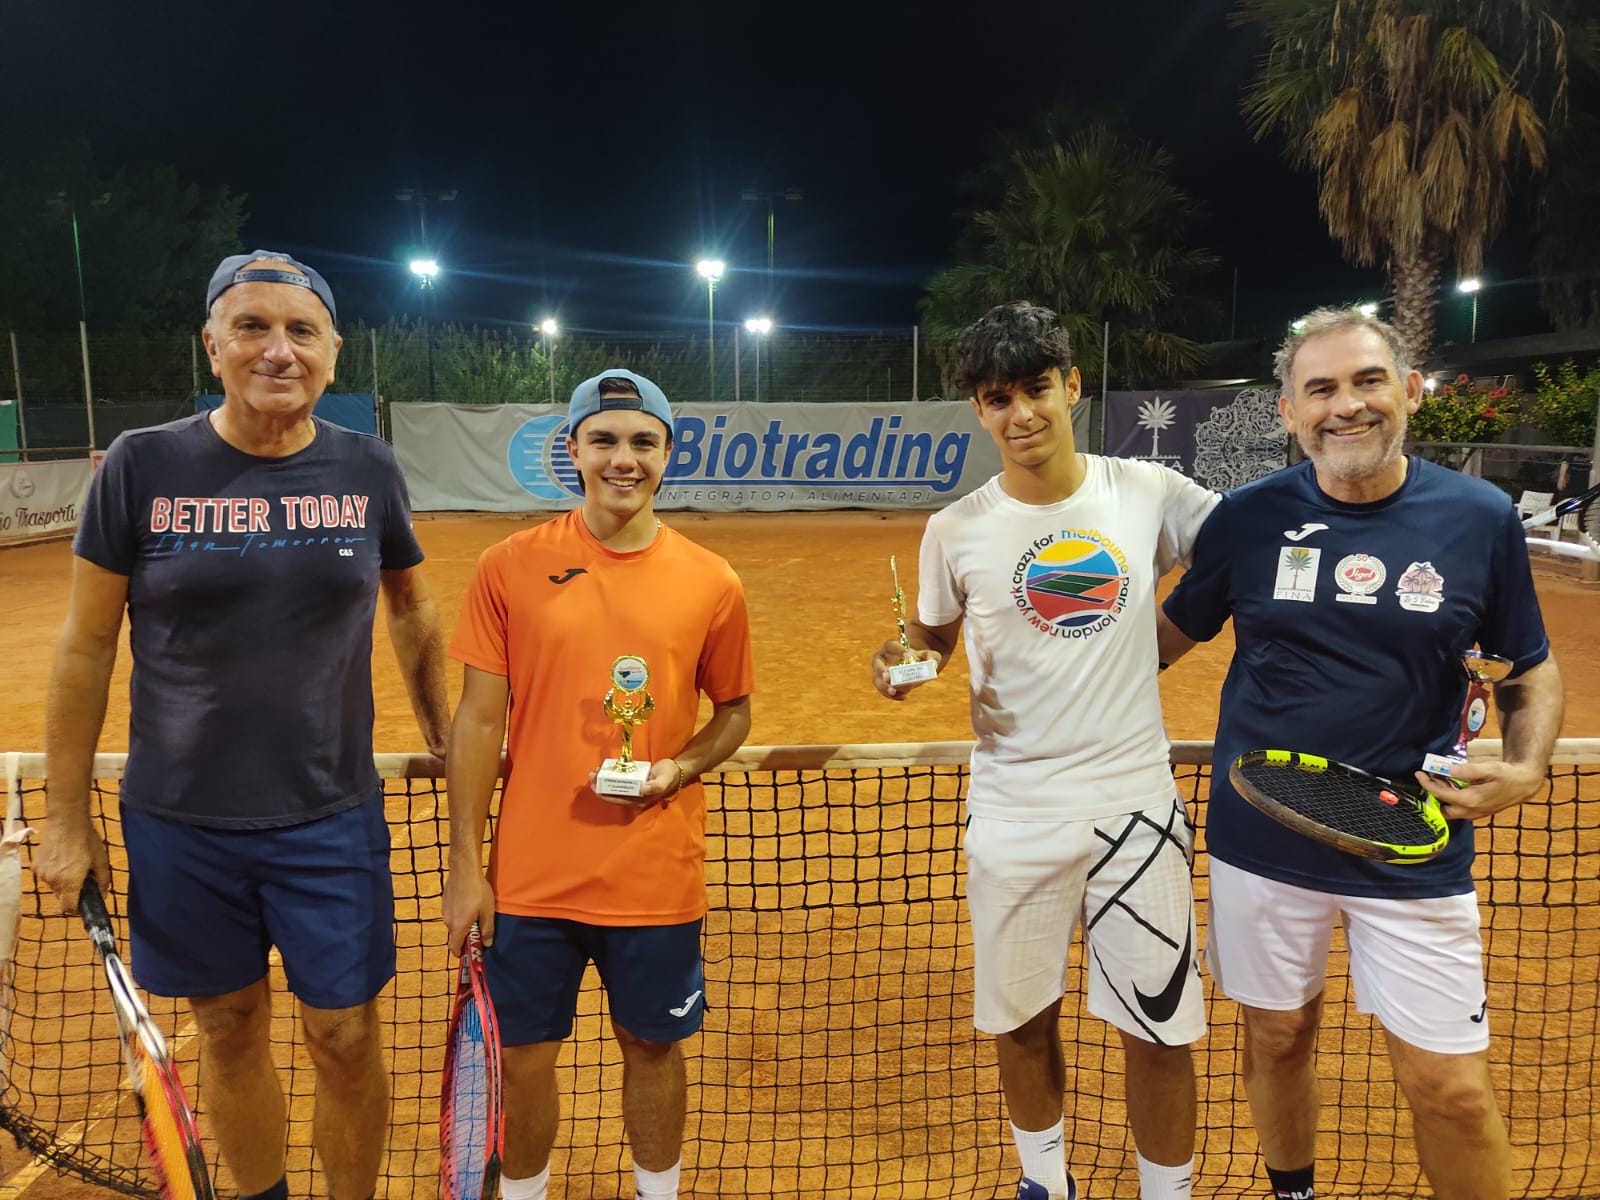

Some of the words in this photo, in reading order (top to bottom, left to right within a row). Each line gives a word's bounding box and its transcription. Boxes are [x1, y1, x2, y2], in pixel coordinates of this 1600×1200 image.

[664, 414, 971, 493] Biotrading
[658, 490, 795, 501] INTEGRATORI
[807, 491, 932, 502] ALIMENTARI
[15, 503, 78, 529] Trasporti
[150, 497, 271, 533] BETTER
[280, 494, 369, 530] TODAY
[240, 532, 367, 557] Tomorrow
[1033, 534, 1054, 551] for
[1061, 527, 1129, 574] melbourne
[1012, 547, 1037, 584] crazy
[1010, 586, 1034, 616] york
[1111, 576, 1130, 614] paris
[1276, 591, 1312, 600] FINA
[1028, 614, 1059, 637] new
[1061, 614, 1117, 640] london
[469, 920, 481, 945] YON
